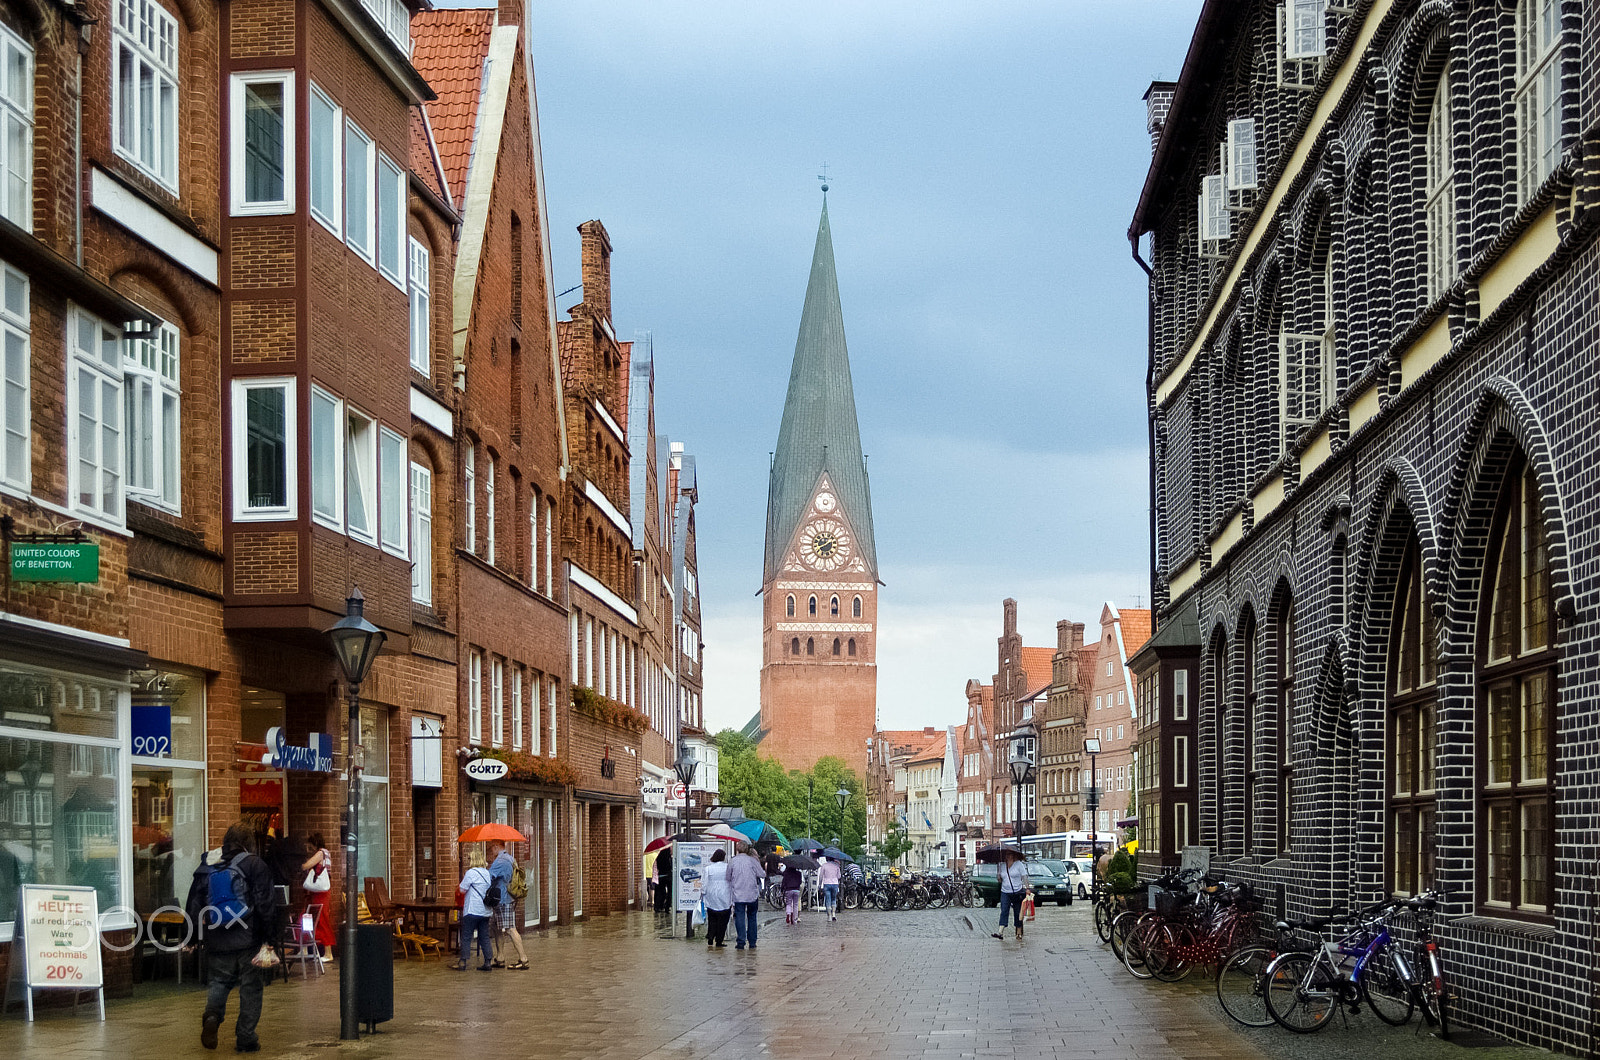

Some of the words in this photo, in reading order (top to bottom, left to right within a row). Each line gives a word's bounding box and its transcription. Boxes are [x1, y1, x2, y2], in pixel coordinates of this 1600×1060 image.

[14, 549, 46, 557] UNITED
[47, 549, 80, 558] COLORS
[14, 560, 26, 569] OF
[38, 901, 84, 913] HEUTE
[51, 930, 74, 938] Ware
[40, 950, 88, 959] nochmals
[46, 965, 83, 980] 20%
